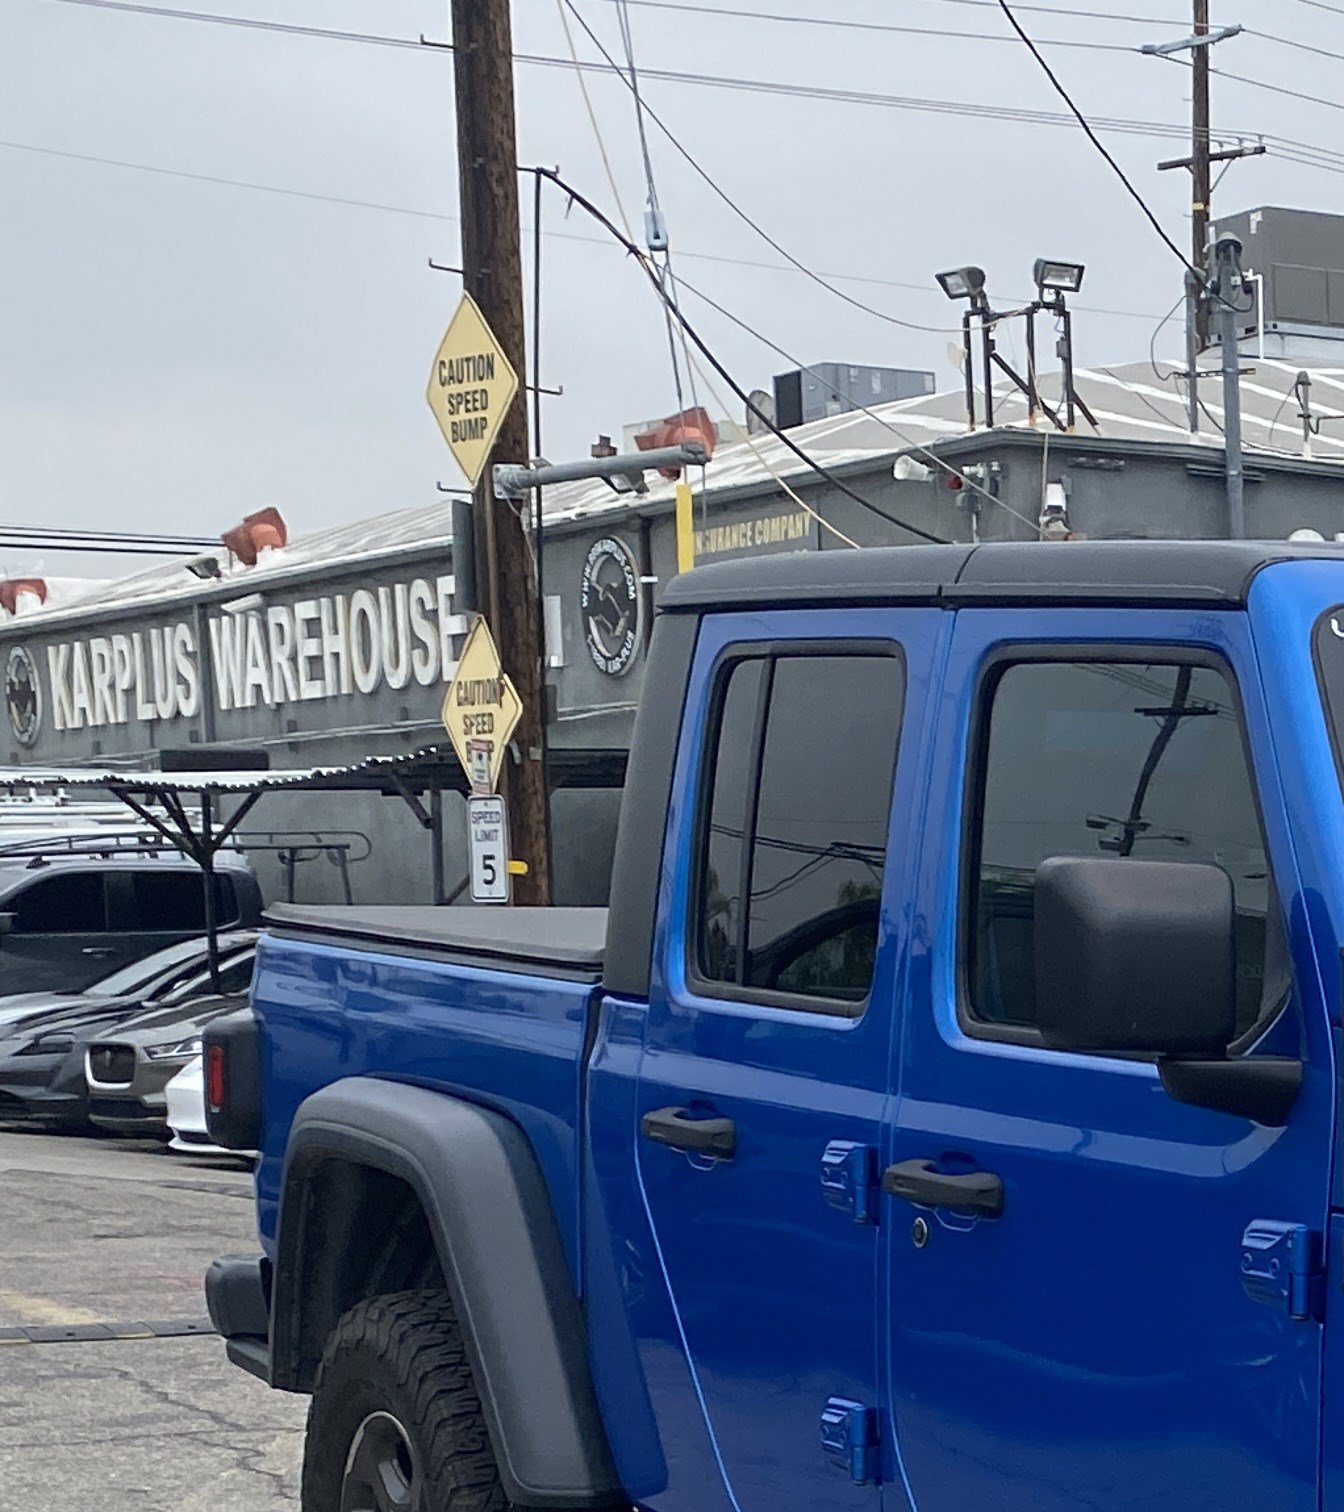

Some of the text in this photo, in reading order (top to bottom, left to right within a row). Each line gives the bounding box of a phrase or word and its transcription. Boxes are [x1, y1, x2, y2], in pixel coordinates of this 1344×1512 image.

[438, 352, 495, 387] CAUTION
[447, 388, 489, 416] SPEED
[450, 416, 488, 443] BUMP
[755, 511, 811, 545] COMPANY
[47, 622, 199, 730] KARPLUS
[208, 574, 468, 711] WAREHOUSE
[456, 679, 502, 706] CAUTION
[463, 712, 495, 736] SPEED
[471, 810, 501, 825] SPEED
[474, 829, 499, 843] LIMIT
[482, 854, 496, 885] 5
